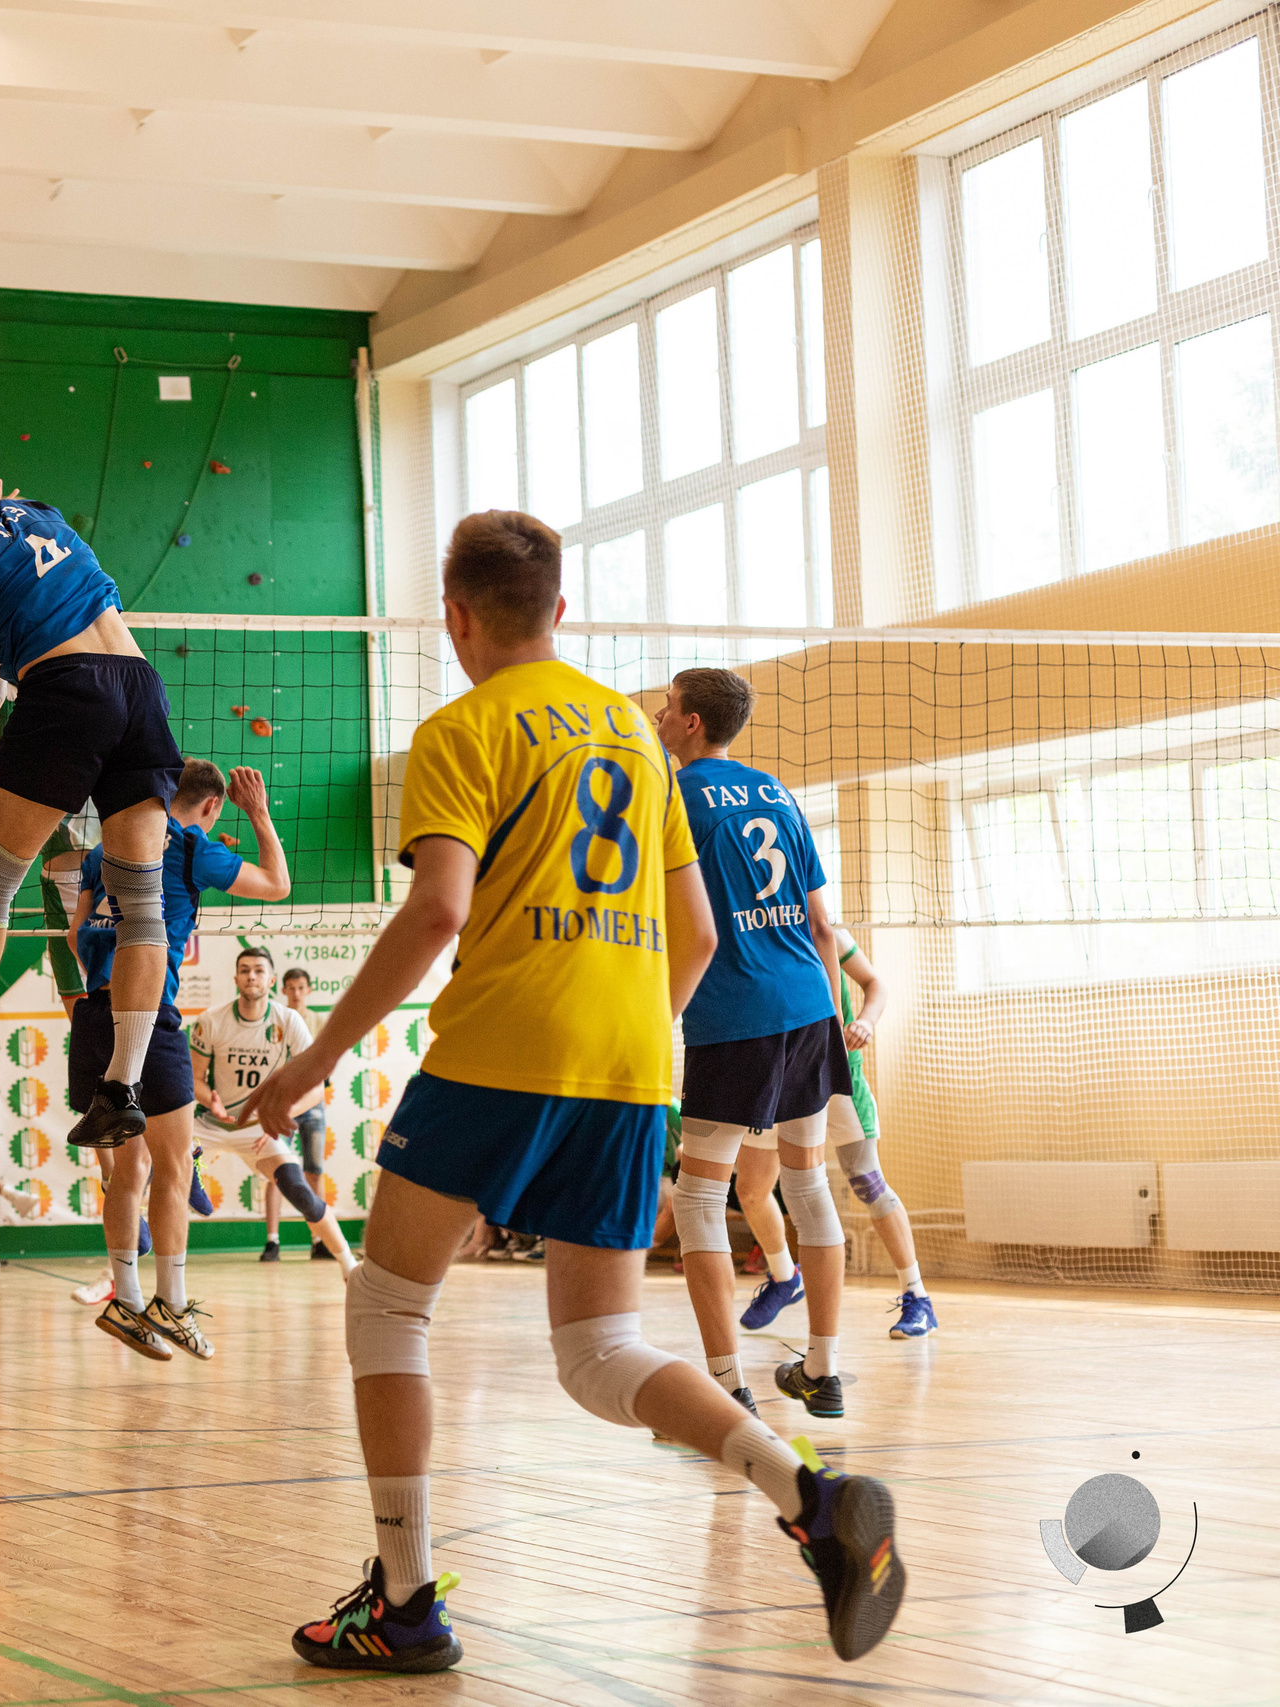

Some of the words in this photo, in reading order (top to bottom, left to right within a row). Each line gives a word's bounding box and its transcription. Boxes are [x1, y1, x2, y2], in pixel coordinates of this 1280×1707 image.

[24, 533, 72, 578] 4
[515, 703, 592, 748] ГАУ
[701, 785, 749, 808] ГАУ
[757, 784, 791, 806] СЗ
[570, 756, 640, 895] 8
[742, 817, 787, 901] 3
[523, 904, 665, 953] ТЮМЕНЬ
[284, 944, 356, 962] +7(3842)
[362, 945, 376, 959] 7
[227, 1054, 269, 1066] ГСХА
[234, 1069, 261, 1089] 10
